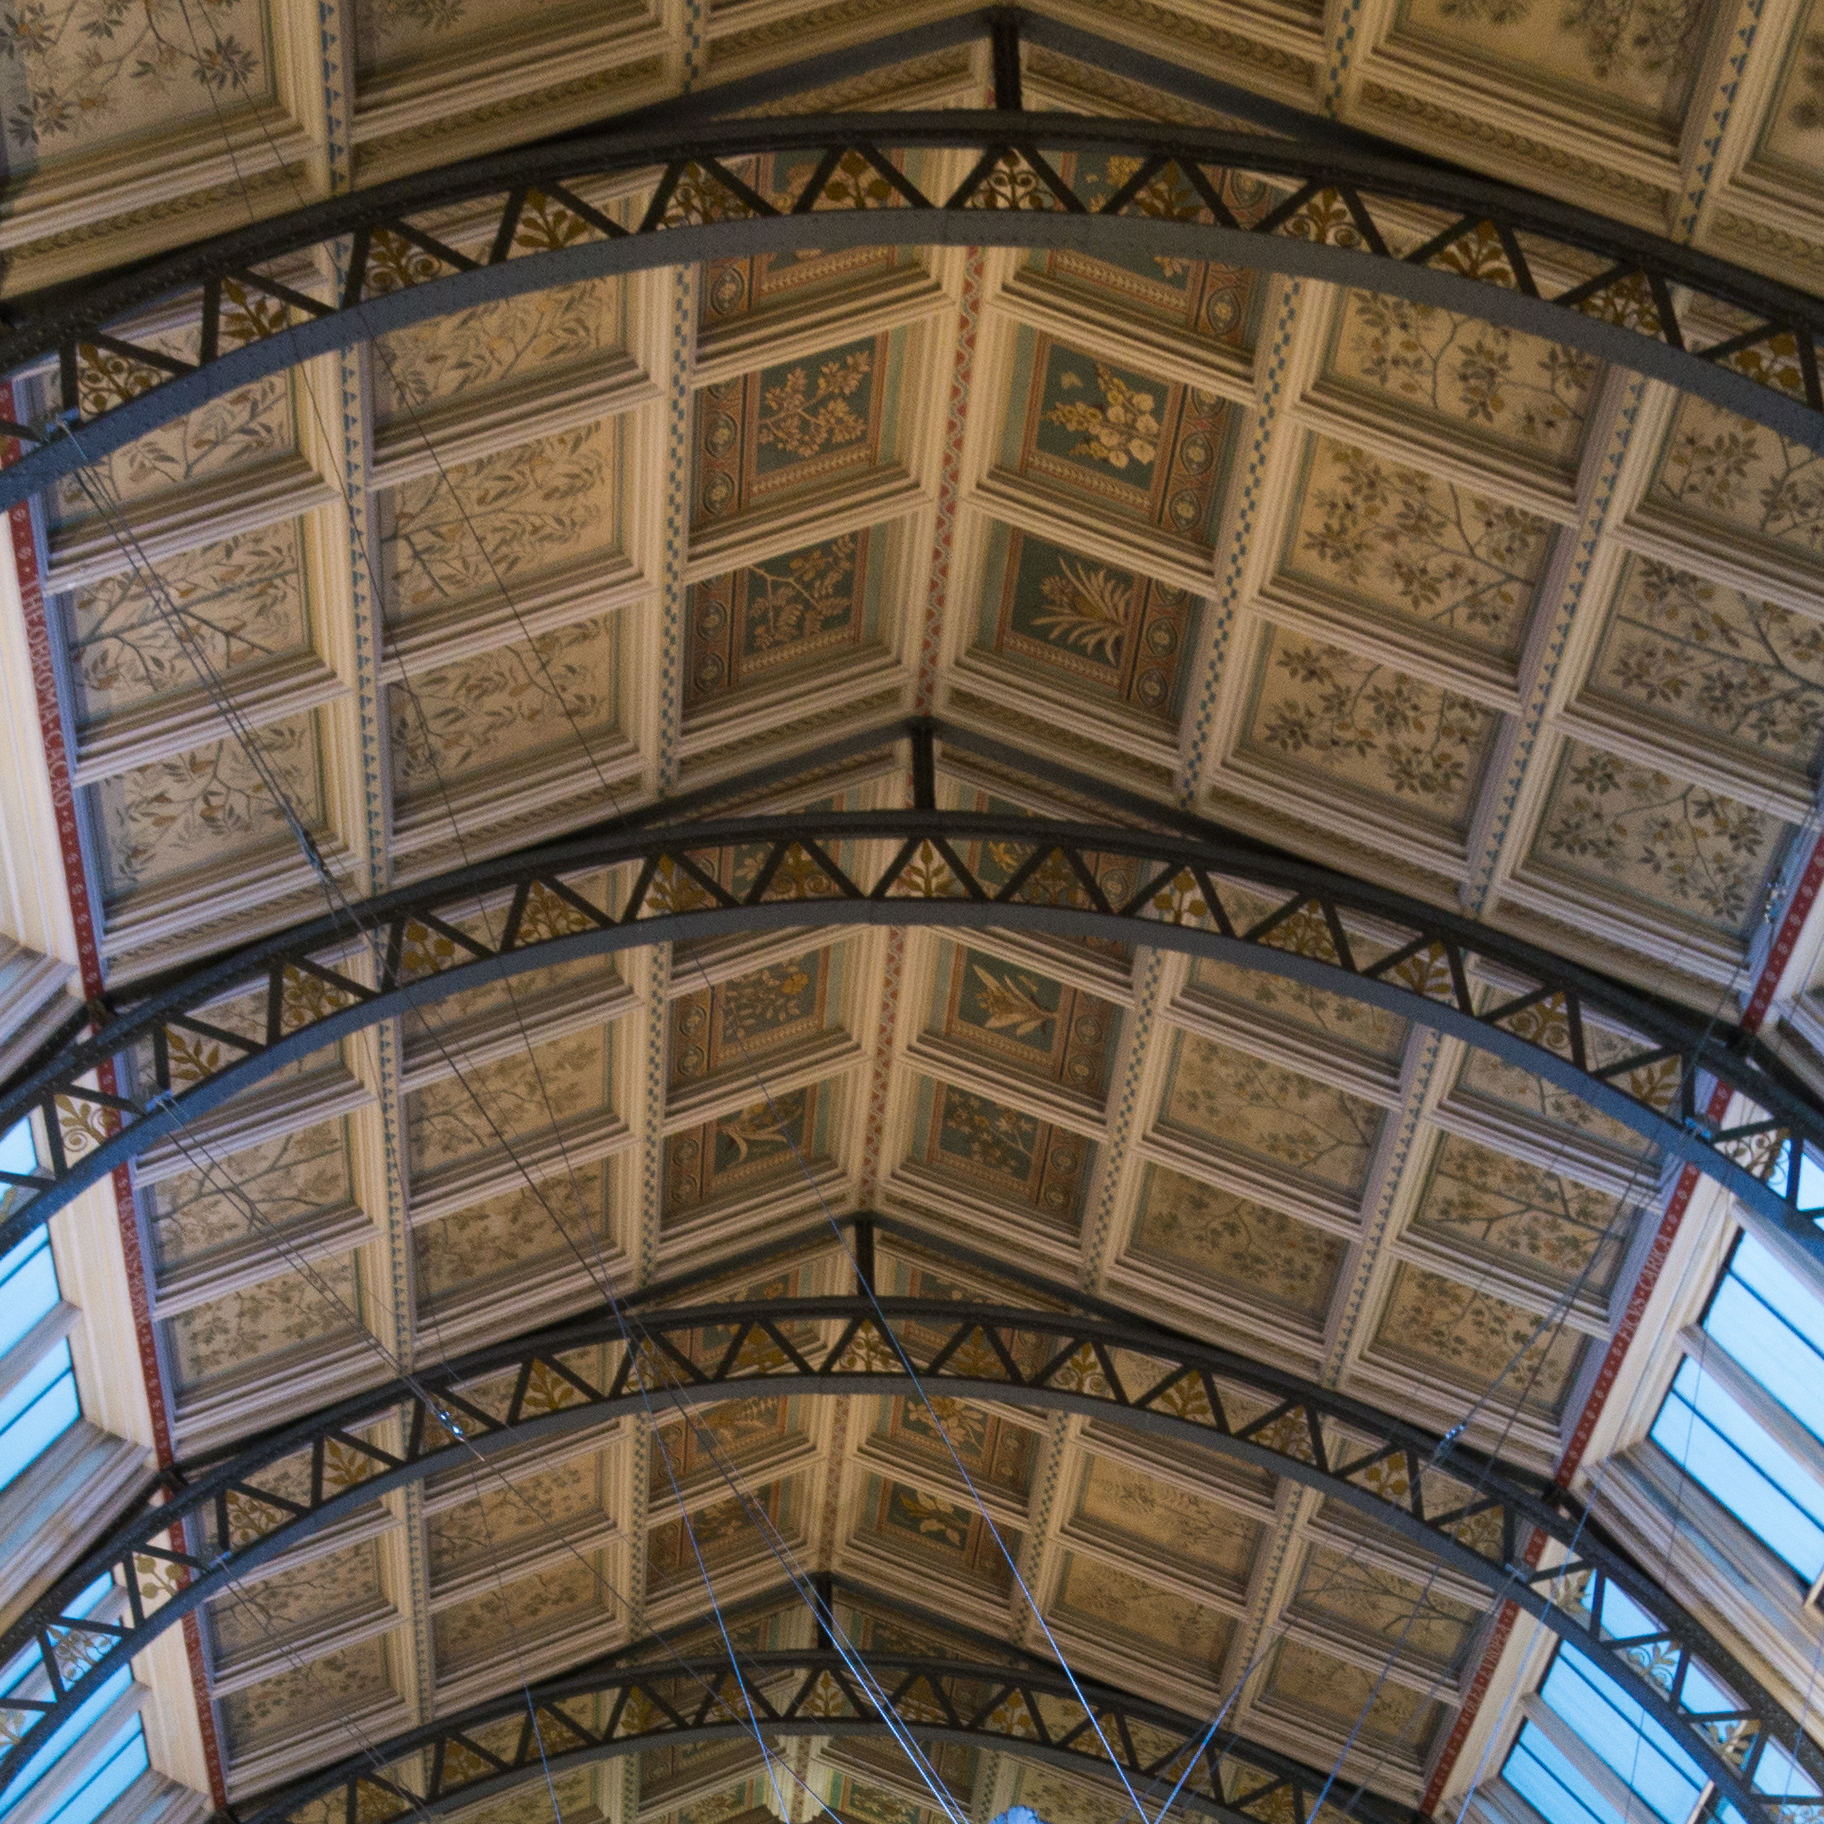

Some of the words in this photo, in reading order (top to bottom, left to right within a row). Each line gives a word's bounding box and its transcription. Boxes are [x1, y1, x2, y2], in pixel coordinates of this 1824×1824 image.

[20, 579, 59, 727] THEOBROMA
[44, 730, 72, 808] CACAO
[1618, 1298, 1646, 1341] FICVS
[1638, 1233, 1673, 1290] CARICA
